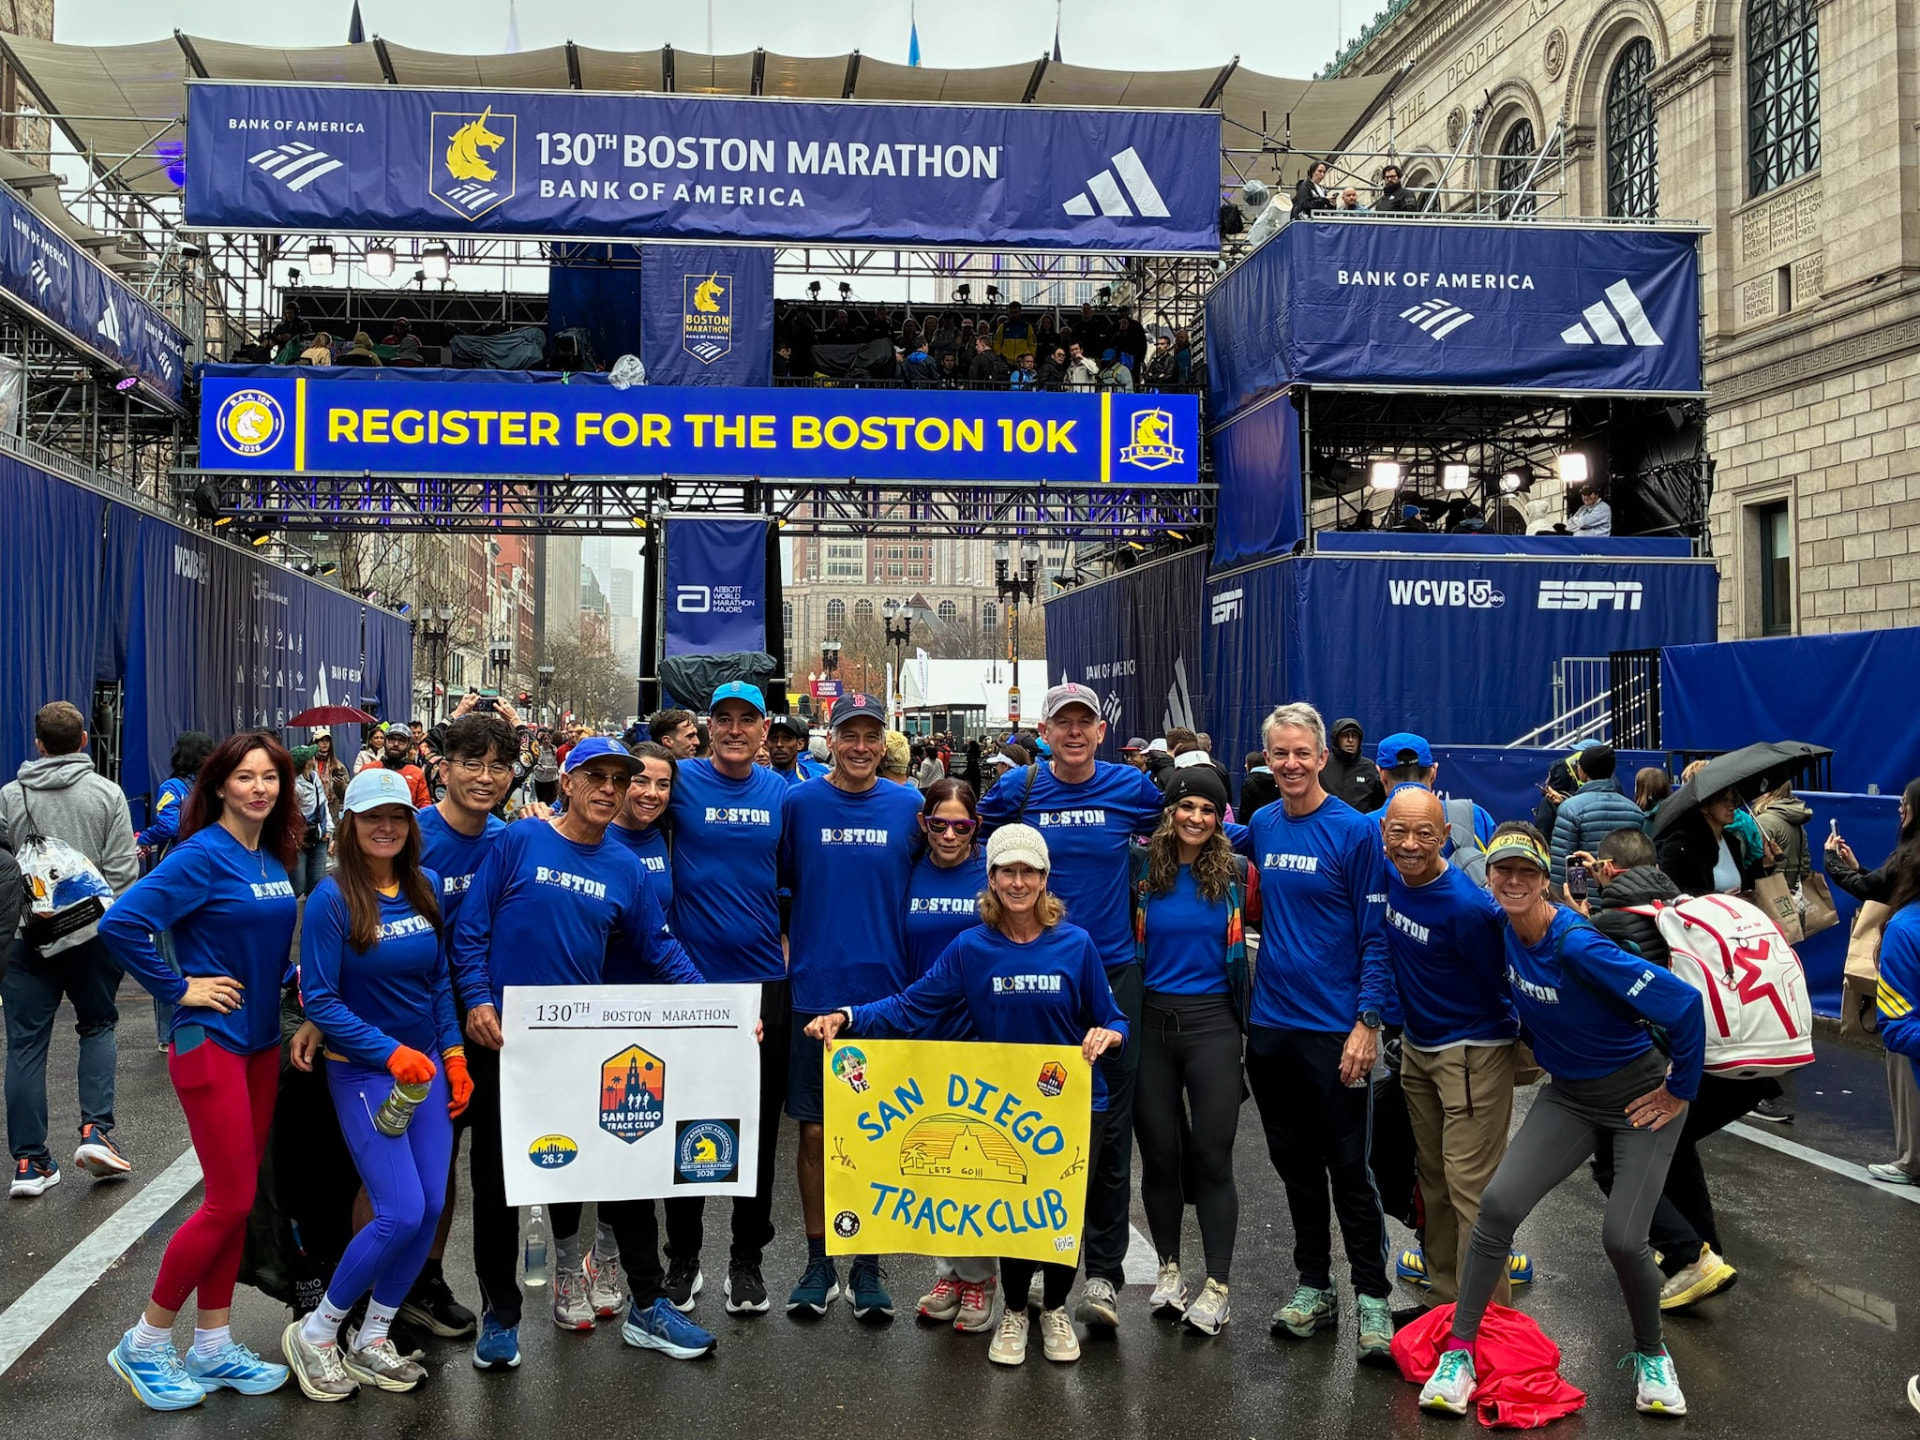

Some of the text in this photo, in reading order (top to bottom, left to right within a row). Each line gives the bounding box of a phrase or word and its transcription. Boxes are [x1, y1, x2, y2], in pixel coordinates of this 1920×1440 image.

[1400, 91, 1426, 129] THE
[1447, 25, 1506, 92] PEOPLE
[229, 118, 366, 134] BANK OF AMERICA
[536, 131, 998, 179] 130TH BOSTON MARATHON
[540, 180, 805, 208] BANK OF AMERICA
[1338, 270, 1535, 290] BANK OF AMERICA
[686, 314, 729, 334] BOSTON MARATHON
[257, 395, 272, 407] 10K
[328, 408, 1078, 454] REGISTER FOR THE BOSTON 10K
[239, 444, 262, 452] 2026
[1136, 446, 1170, 456] B.A.A.
[1538, 580, 1643, 610] ESPN
[1212, 588, 1243, 626] ESPN
[1066, 682, 1078, 694] B
[852, 694, 866, 707] B
[705, 807, 770, 824] BOSTON
[1039, 810, 1105, 826] BOSTON
[821, 828, 888, 844] BOSTON
[1264, 853, 1318, 870] BOSTON
[536, 866, 607, 899] BOSTON
[910, 898, 975, 913] BOSTON
[992, 974, 1061, 992] BOSTON
[602, 1010, 652, 1022] BOSTON
[662, 1008, 730, 1021] MARATHON
[602, 1111, 661, 1121] SAN DIEGO
[857, 1074, 1065, 1156] SAN DIEGO
[541, 1153, 564, 1164] 26.2
[928, 1166, 951, 1174] LETS
[870, 1182, 1068, 1238] TRACK CLUB
